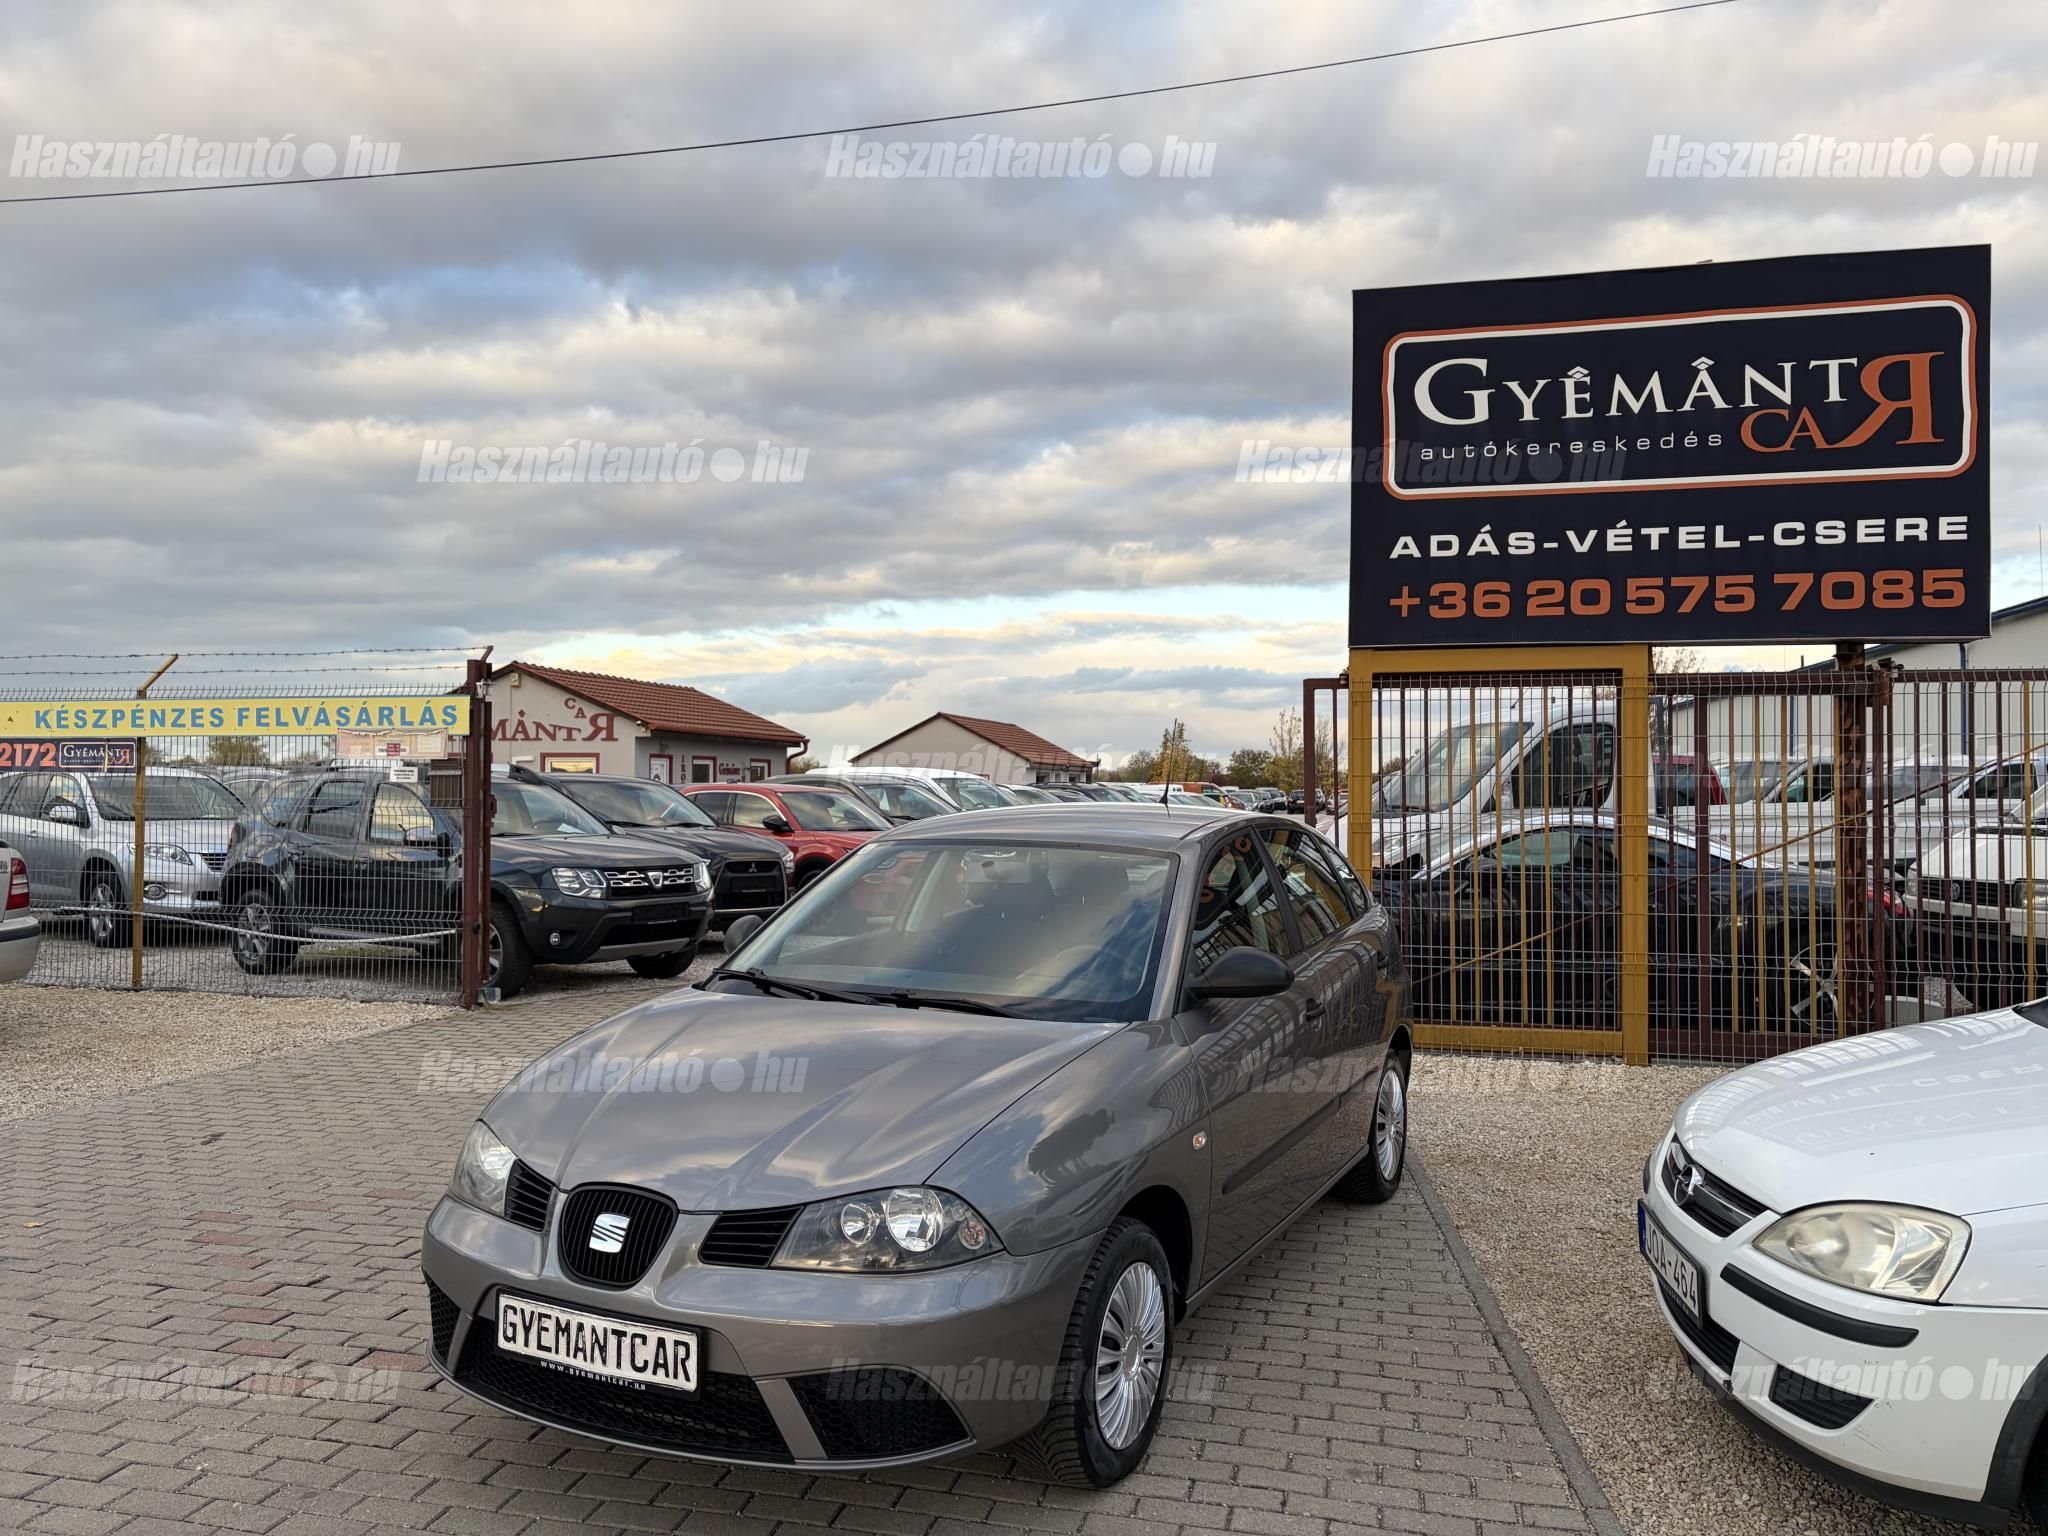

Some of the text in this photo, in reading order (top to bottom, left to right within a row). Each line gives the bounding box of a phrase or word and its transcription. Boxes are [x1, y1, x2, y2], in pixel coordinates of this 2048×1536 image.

[1420, 430, 1723, 460] autókereskedés
[1390, 568, 1966, 618] +36 20 575 7085
[35, 700, 458, 729] KÉSZPÉNZES FELVÁSÁRLÁS
[502, 1304, 691, 1382] GYEMANTCAR
